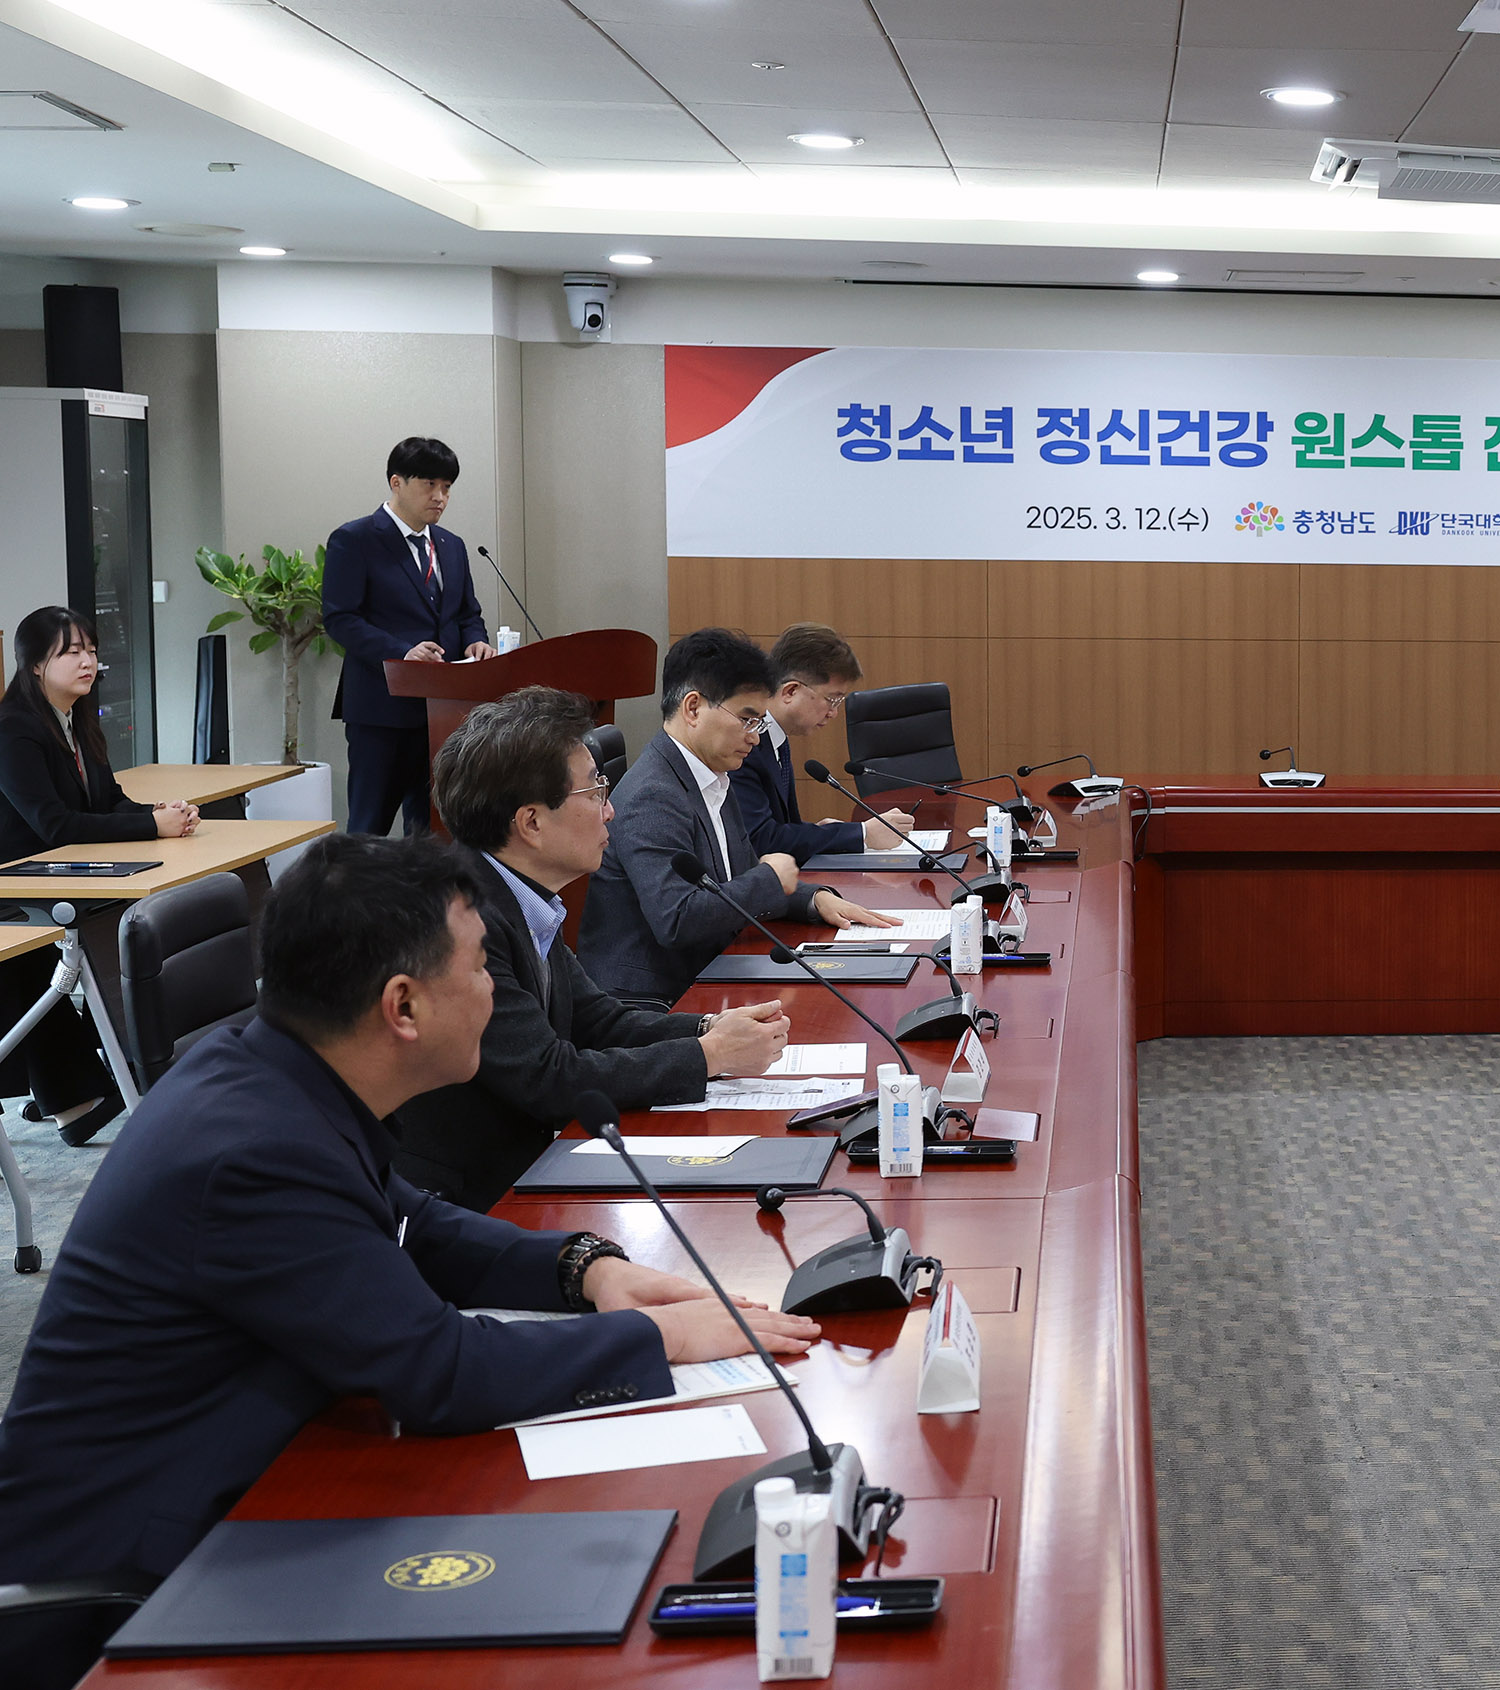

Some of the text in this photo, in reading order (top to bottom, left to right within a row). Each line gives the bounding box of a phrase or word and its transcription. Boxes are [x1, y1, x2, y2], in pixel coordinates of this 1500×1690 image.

[836, 402, 1014, 465] 청소년
[1036, 407, 1275, 468] 정신건강
[1291, 411, 1464, 472] 원스톱
[1026, 506, 1210, 532] 2025. 3. 12.(수)
[1292, 510, 1377, 535] 충청남도
[1398, 511, 1430, 536] DKU
